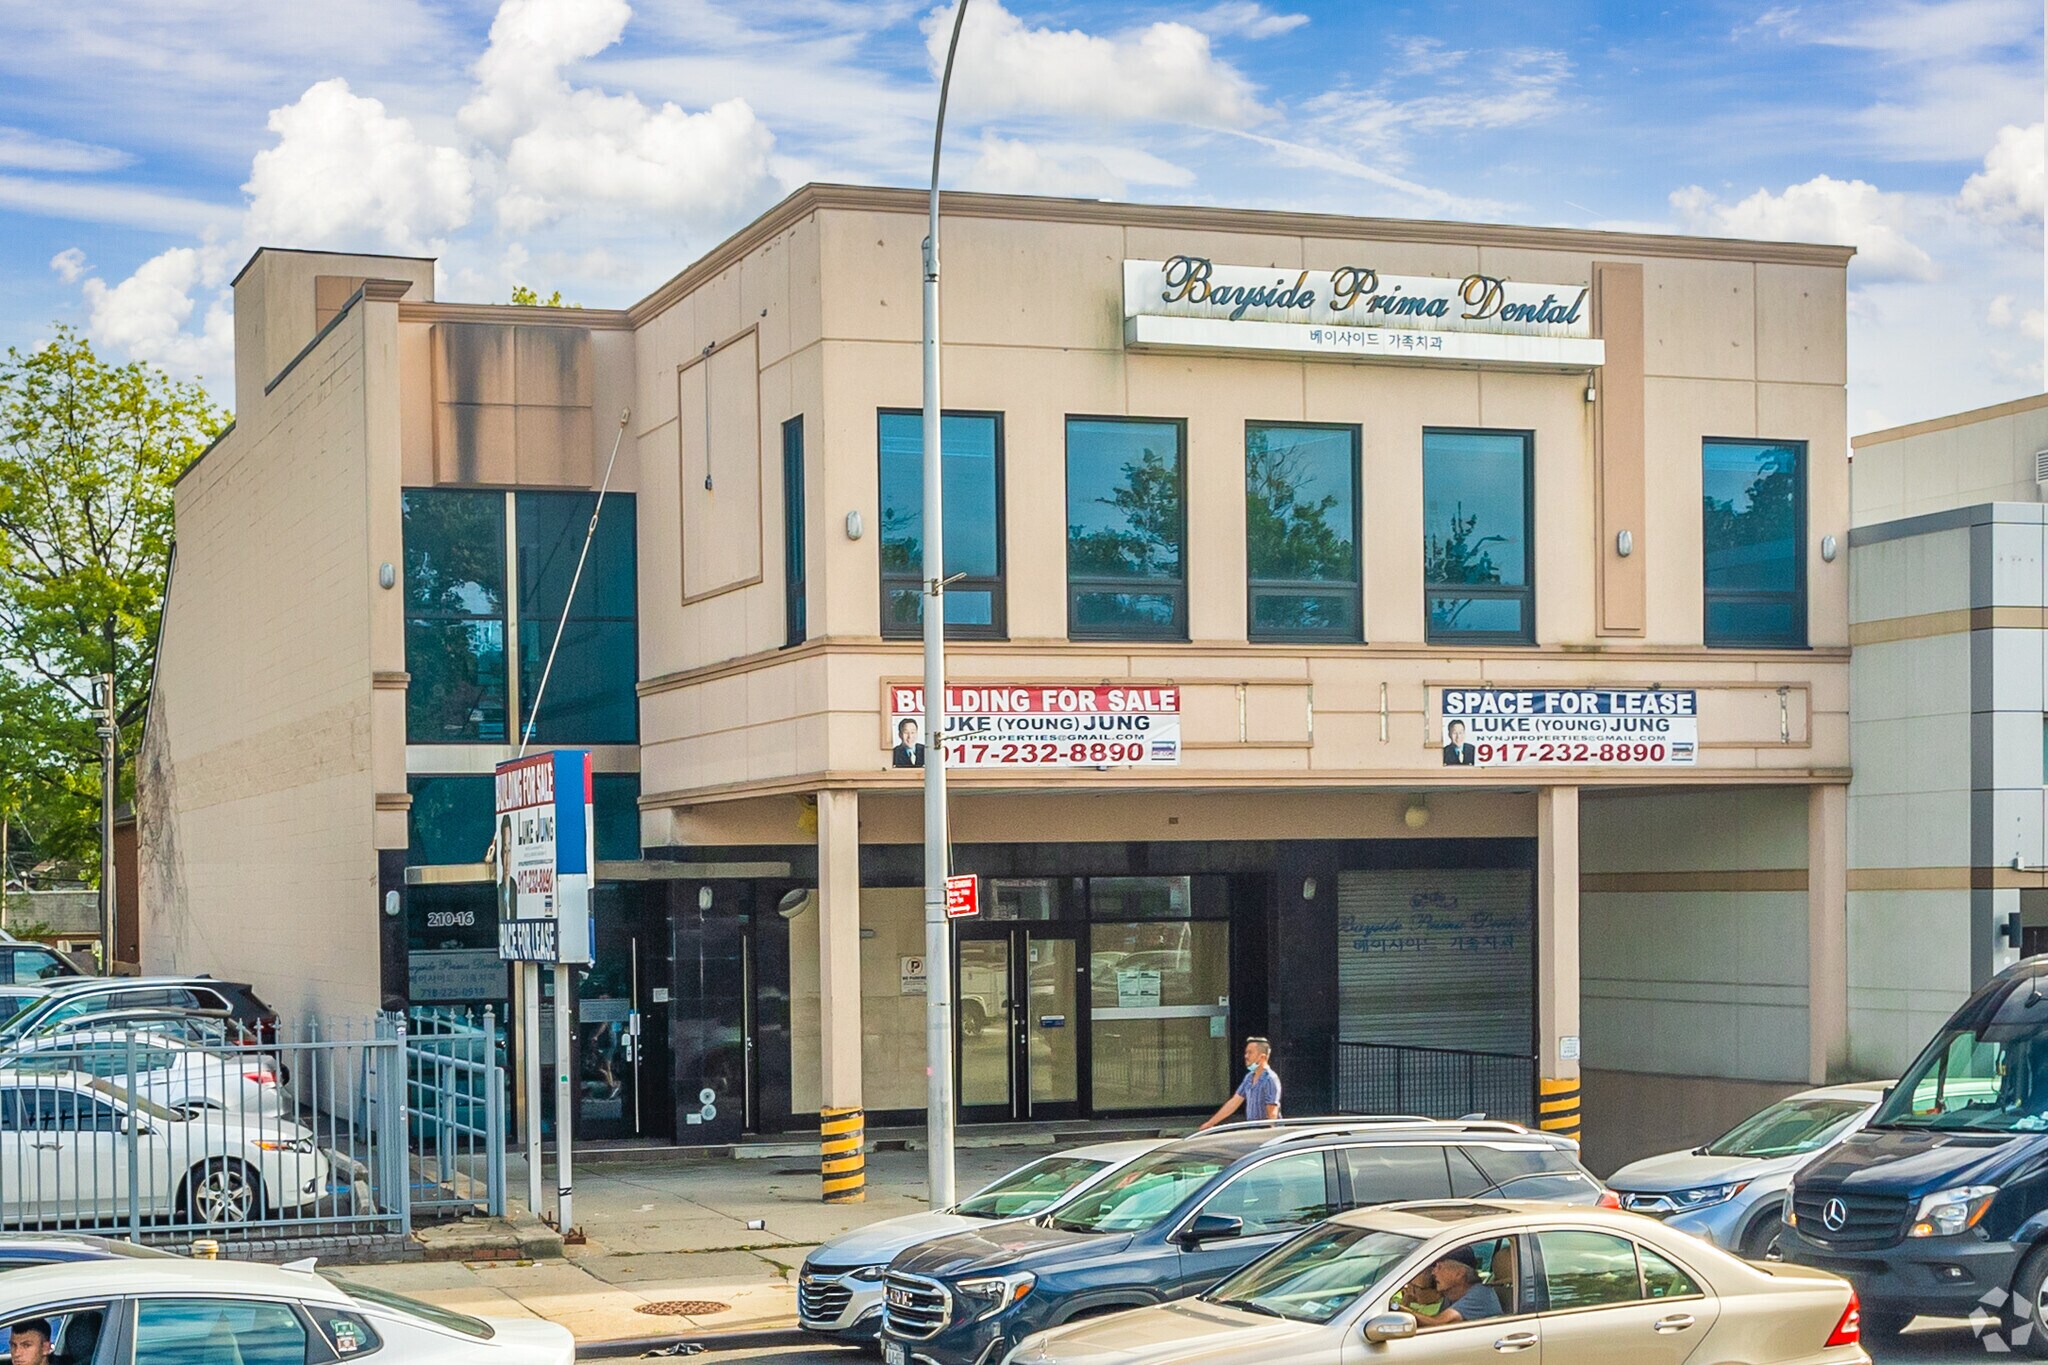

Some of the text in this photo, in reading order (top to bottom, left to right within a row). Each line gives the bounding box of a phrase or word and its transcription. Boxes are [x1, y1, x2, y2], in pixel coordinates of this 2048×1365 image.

[1161, 255, 1589, 325] Bayside Prima Dental
[1310, 330, 1443, 351] 베이사이드 가족치과
[896, 689, 1175, 712] BLDING FOR SALE
[1446, 692, 1692, 714] SPACE FOR LEASE
[945, 715, 1150, 732] UKE (YOUNG) JUNG
[1471, 718, 1670, 732] LUKE (YOUNG) JUNG
[950, 734, 1145, 742] NJPROPERTIES@GMAIL.COM
[945, 743, 1144, 764] 17-232-8890
[1477, 743, 1665, 763] 917-232-8890
[427, 911, 475, 927] 210-16
